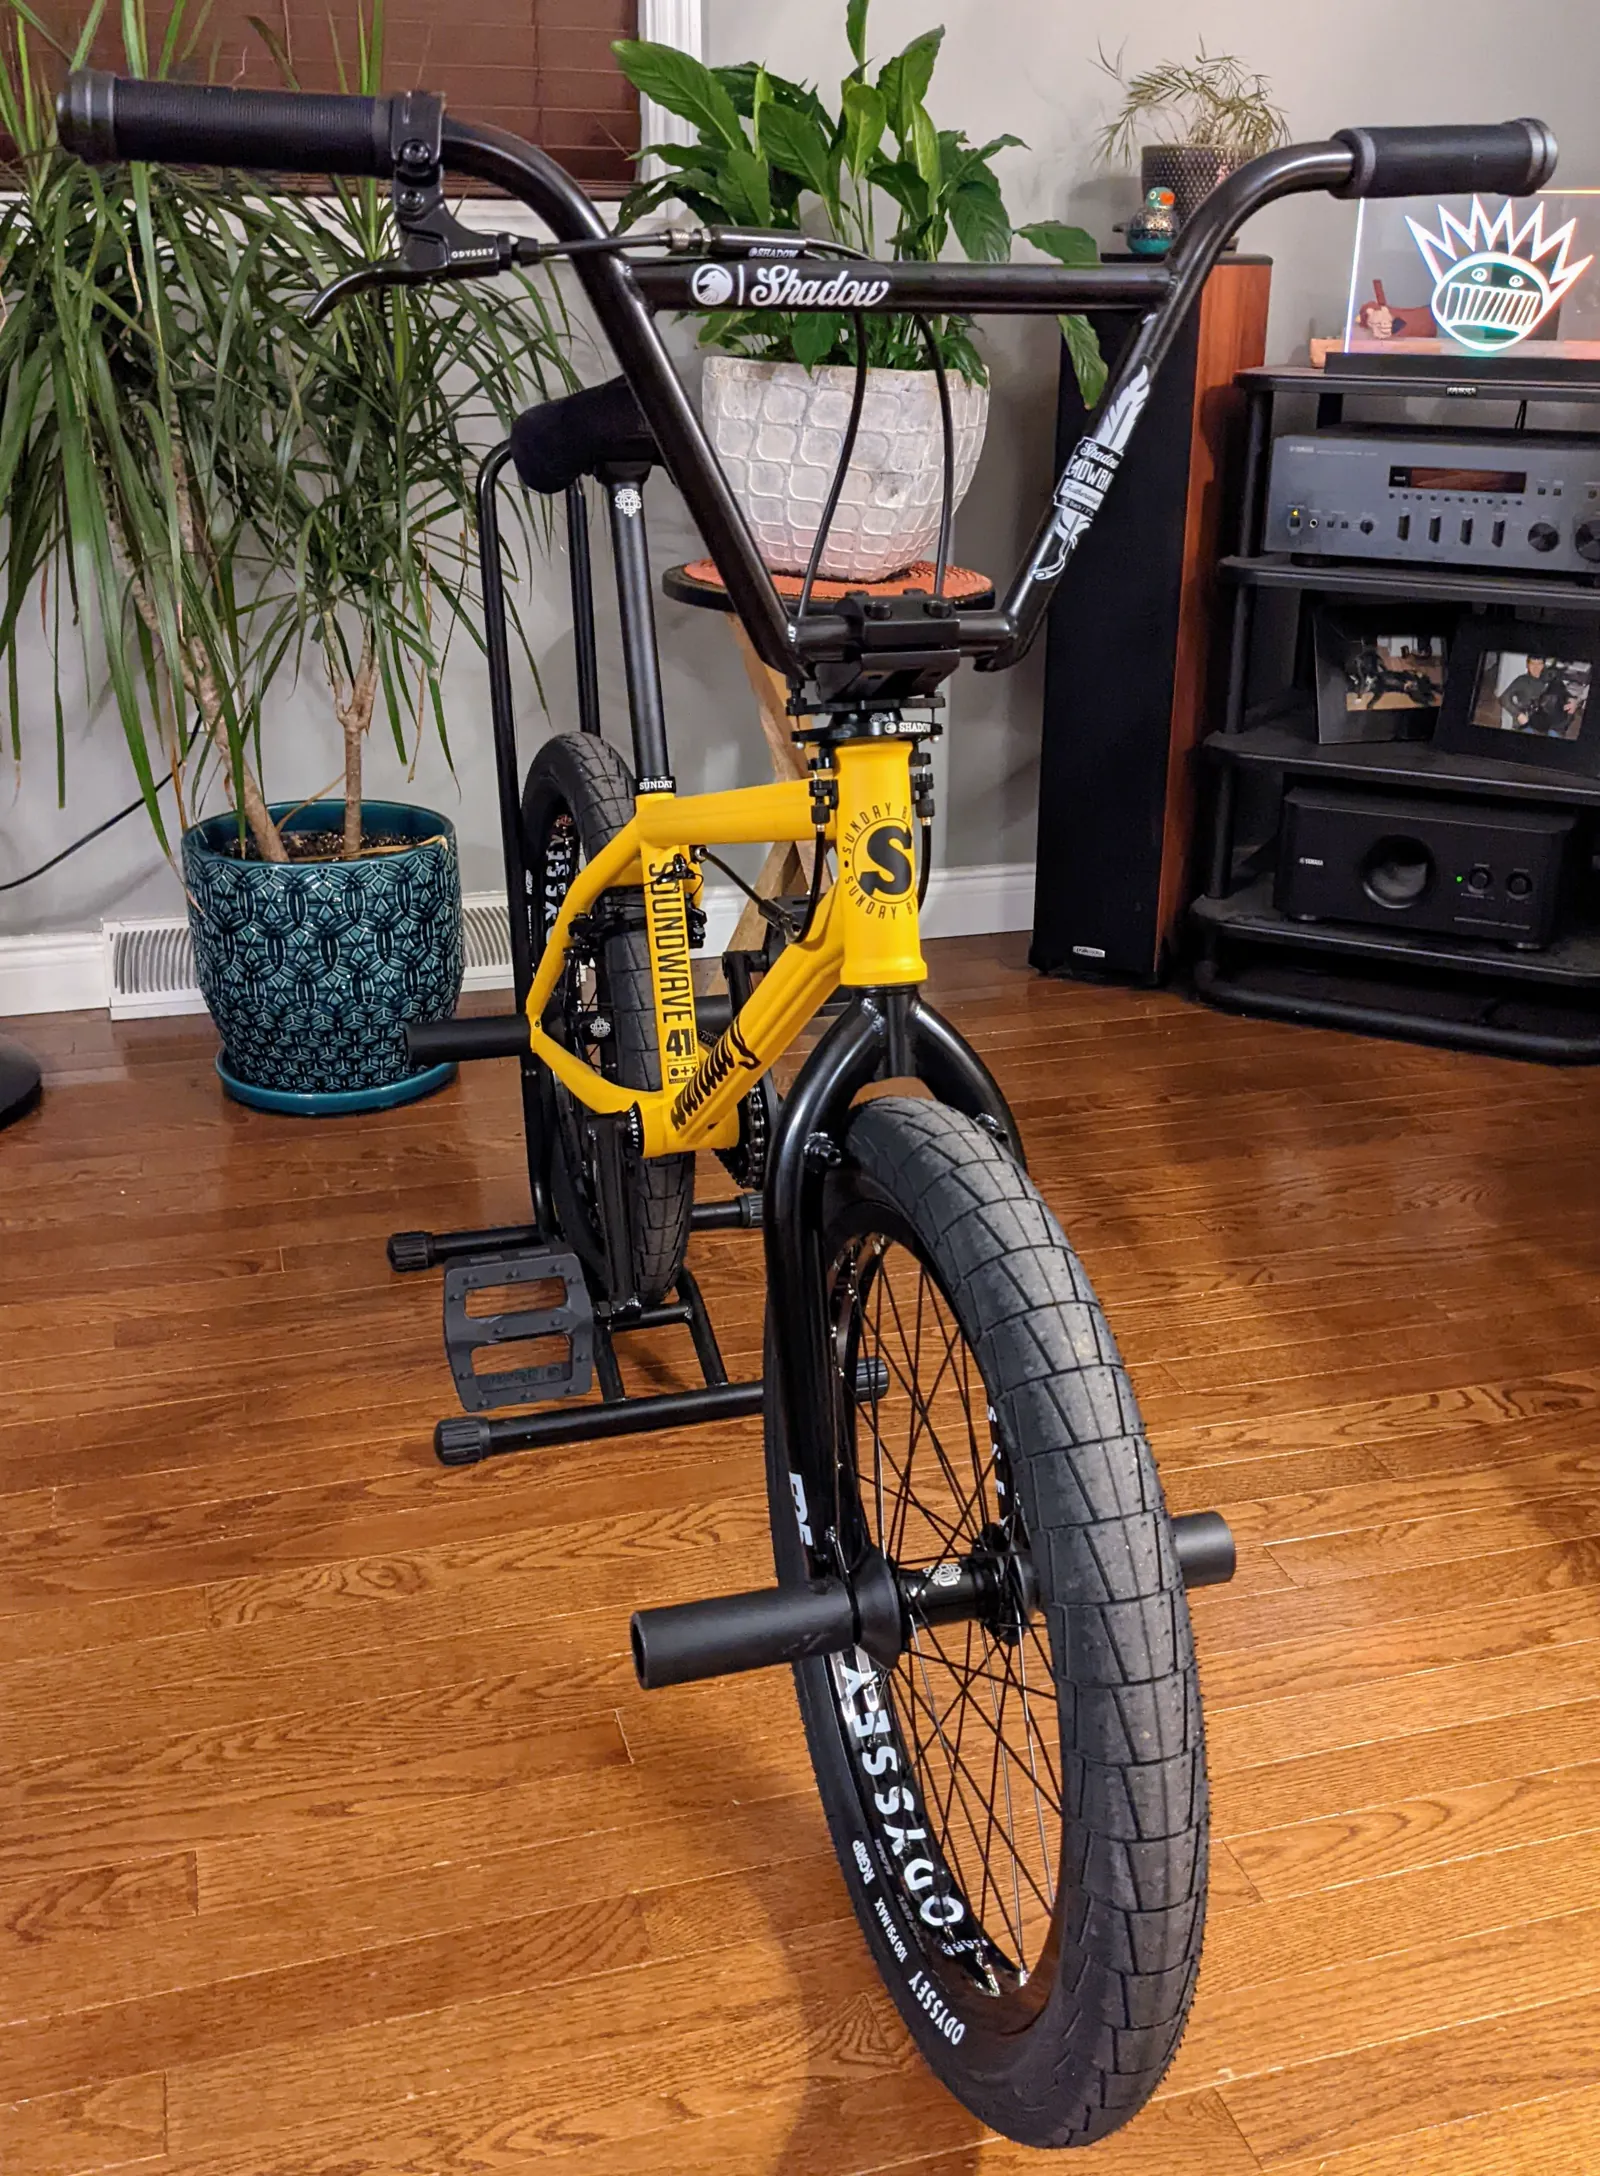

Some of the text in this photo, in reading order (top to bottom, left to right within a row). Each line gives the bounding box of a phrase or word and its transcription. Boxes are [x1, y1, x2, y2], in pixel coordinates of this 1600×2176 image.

[451, 248, 494, 259] ODYSSEY
[758, 247, 799, 258] SHADOW
[750, 264, 890, 306] Shadow
[639, 780, 673, 790] SUNDAY
[842, 802, 892, 855] SUNDAY
[860, 825, 913, 897] S
[844, 875, 898, 920] SUNDAY
[648, 862, 693, 1024] SOUNDWAVE
[666, 1028, 692, 1057] 41
[840, 1664, 964, 1926] ODYSSEY
[873, 1896, 908, 1963] 100 PSI MAX
[907, 1970, 966, 2046] ODYSSEY
